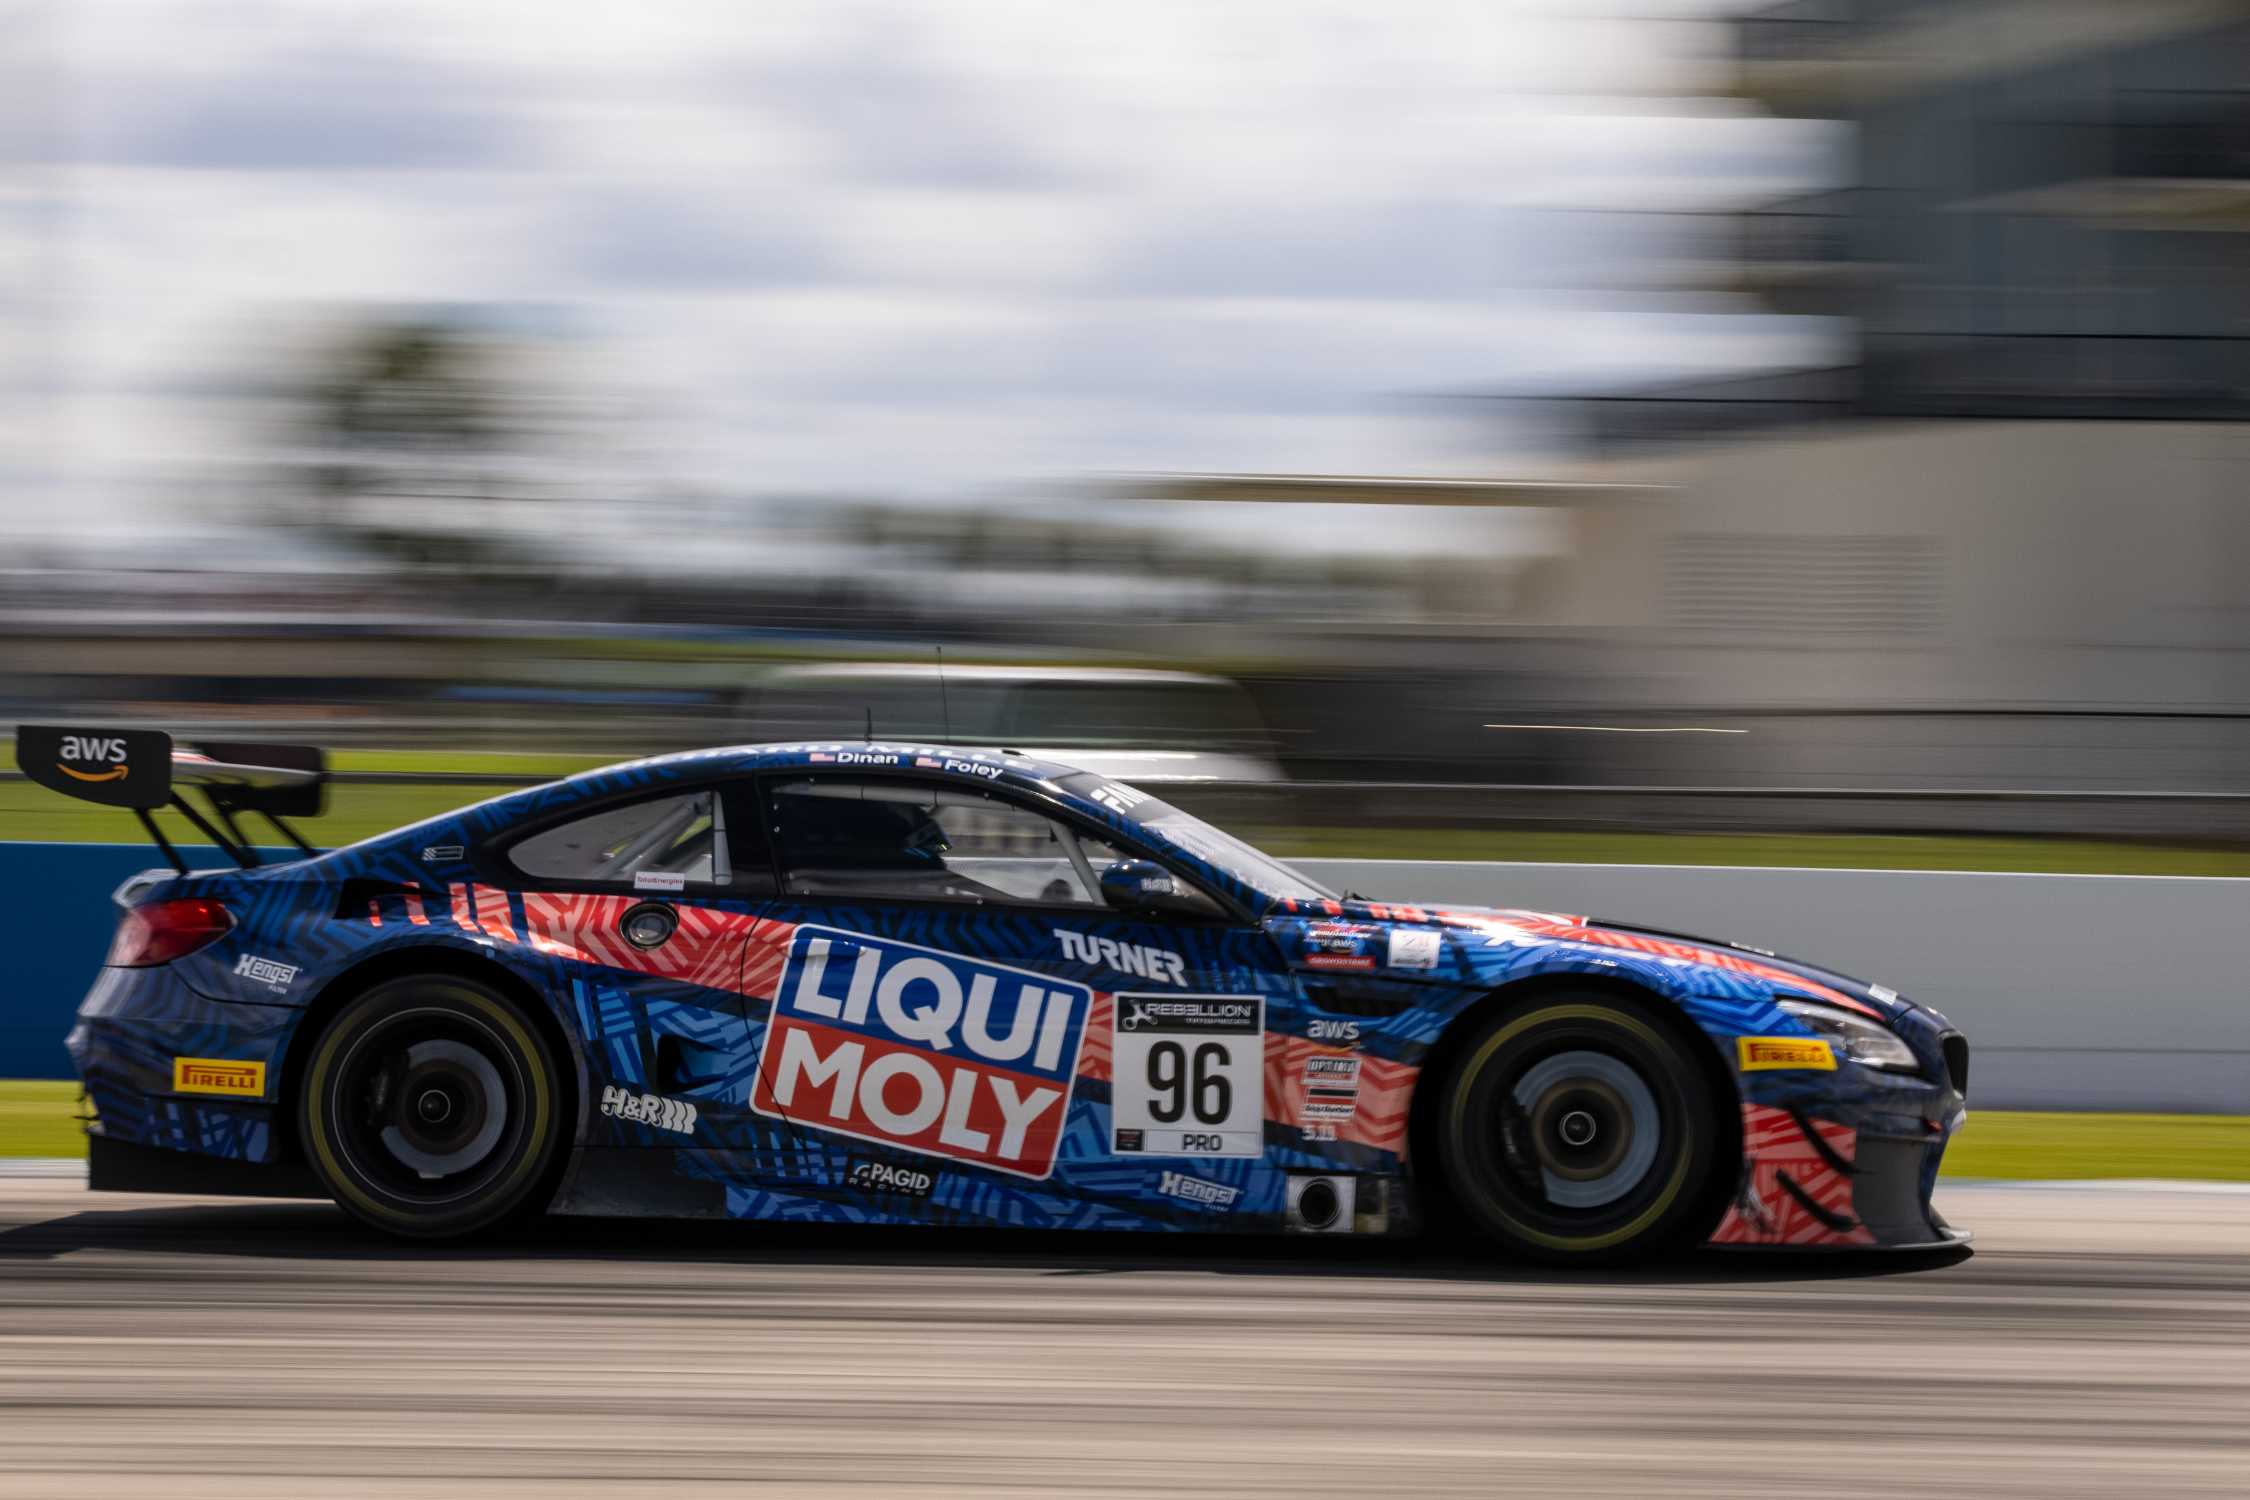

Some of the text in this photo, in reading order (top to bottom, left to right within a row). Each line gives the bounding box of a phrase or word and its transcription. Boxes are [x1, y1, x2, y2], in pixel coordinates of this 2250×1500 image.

[60, 736, 127, 762] aws
[837, 752, 898, 765] Dinan
[945, 759, 1002, 779] Foley
[232, 953, 300, 984] Hengst
[1053, 928, 1187, 987] TURNER
[793, 937, 1074, 1072] LIQUI
[1307, 1020, 1360, 1040] aws
[1749, 1043, 1825, 1063] PIRELLI
[182, 1064, 257, 1089] PIRELLI
[1147, 1040, 1233, 1125] 96
[771, 1027, 1063, 1161] MOLY
[1182, 1134, 1223, 1151] PRO
[870, 1163, 931, 1189] PAGID
[1158, 1170, 1238, 1204] Hengst
